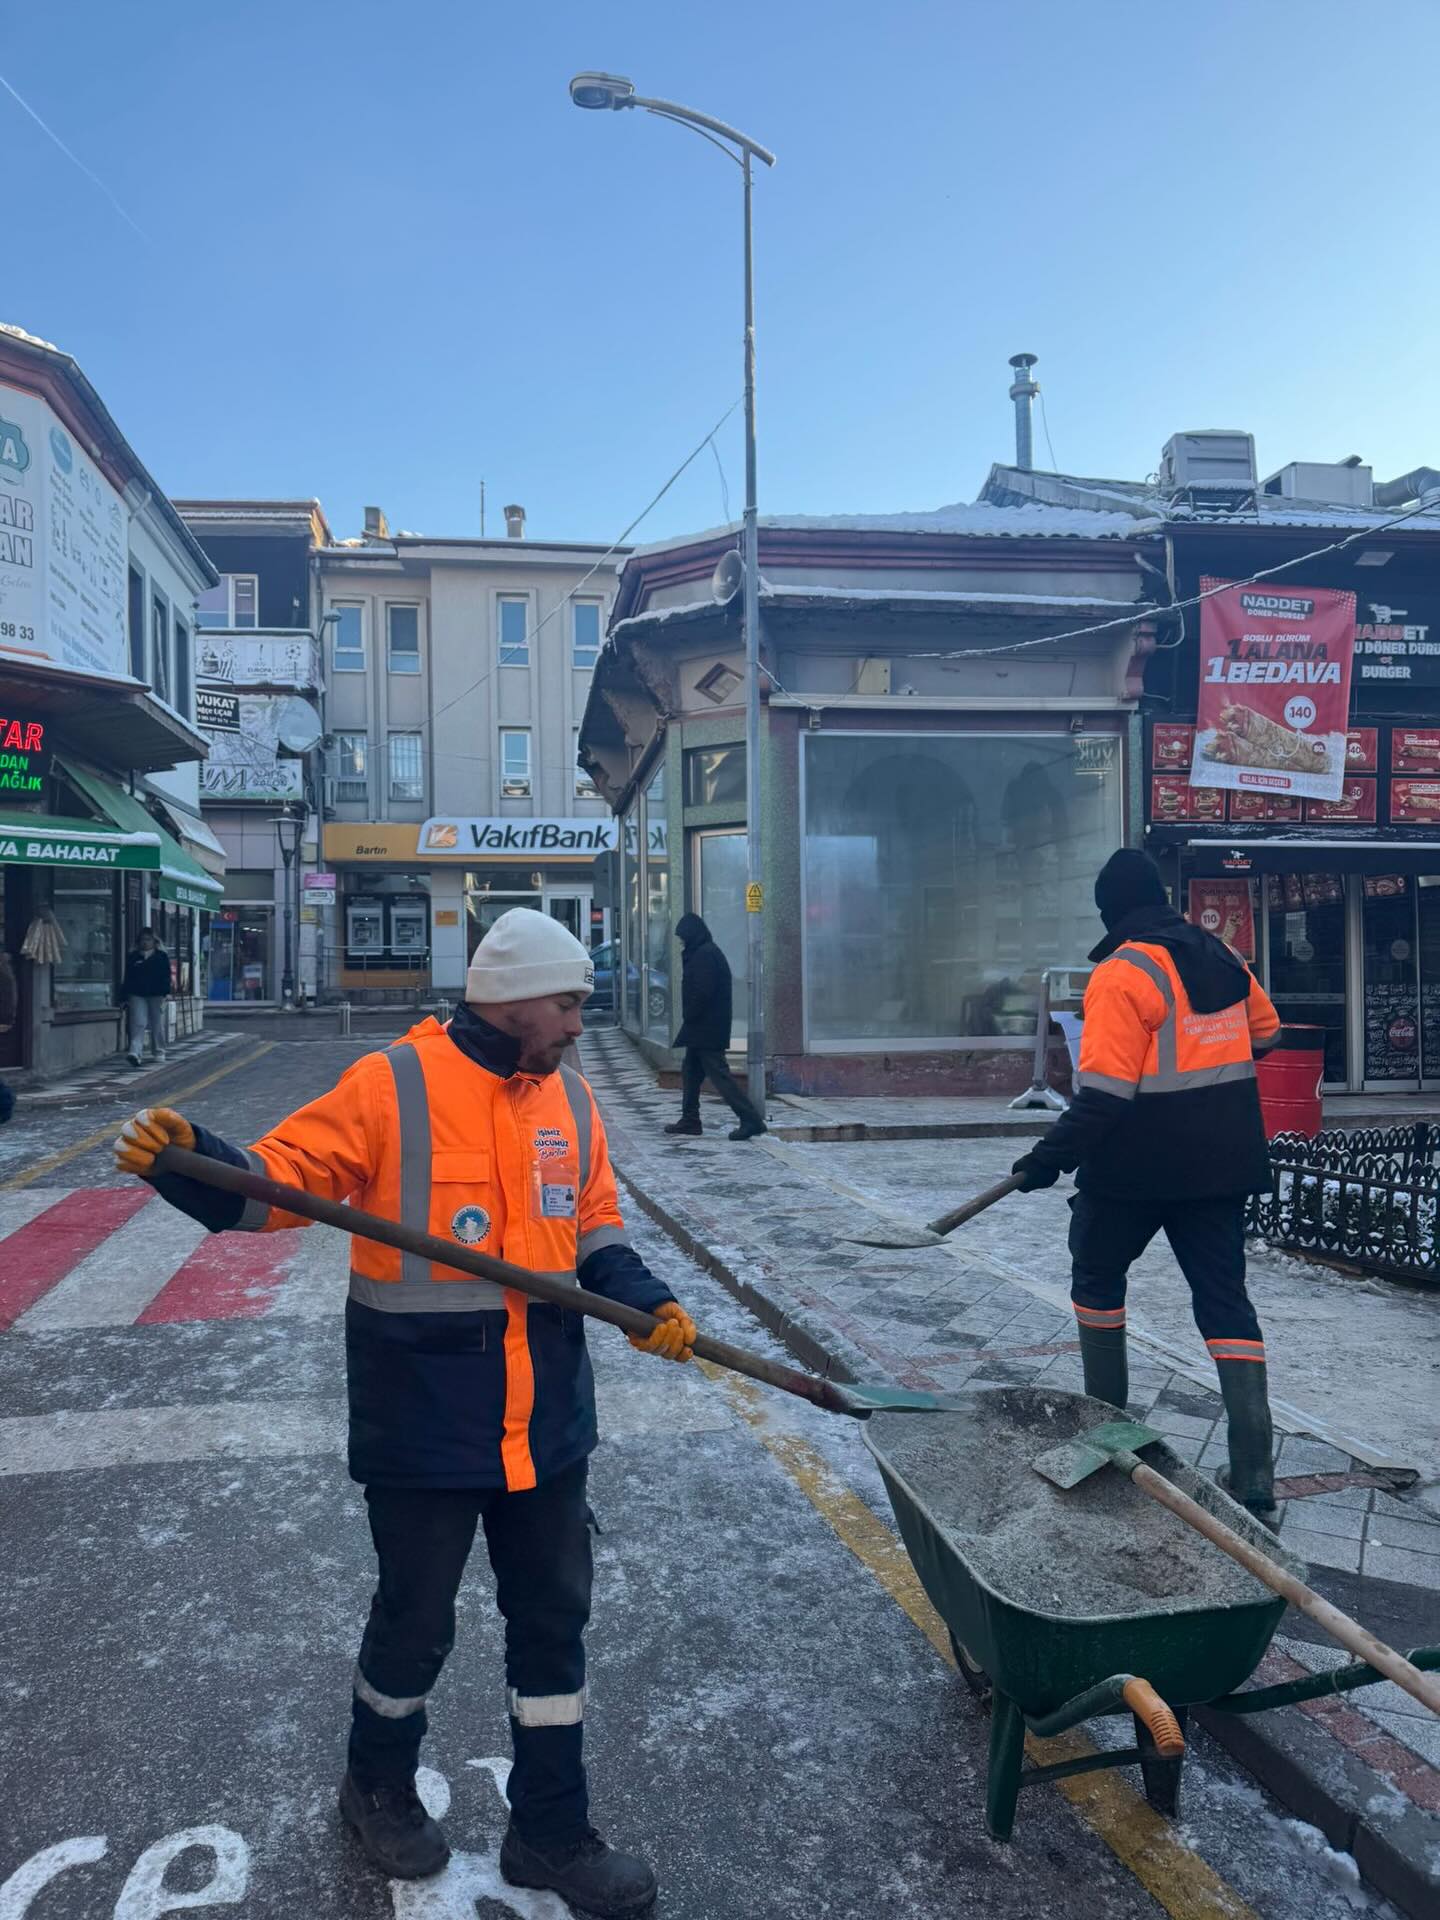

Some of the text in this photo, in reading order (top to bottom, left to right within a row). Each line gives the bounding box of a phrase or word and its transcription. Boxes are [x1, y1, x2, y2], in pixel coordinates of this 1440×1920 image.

[1243, 595, 1312, 612] NADDET
[0, 622, 35, 641] 98 33
[1364, 641, 1407, 655] DÖNER
[1361, 665, 1411, 679] BURGER
[1289, 706, 1312, 718] 140
[0, 754, 29, 771] DAN
[470, 824, 611, 849] VakıfBank
[26, 843, 120, 862] BAHARAT
